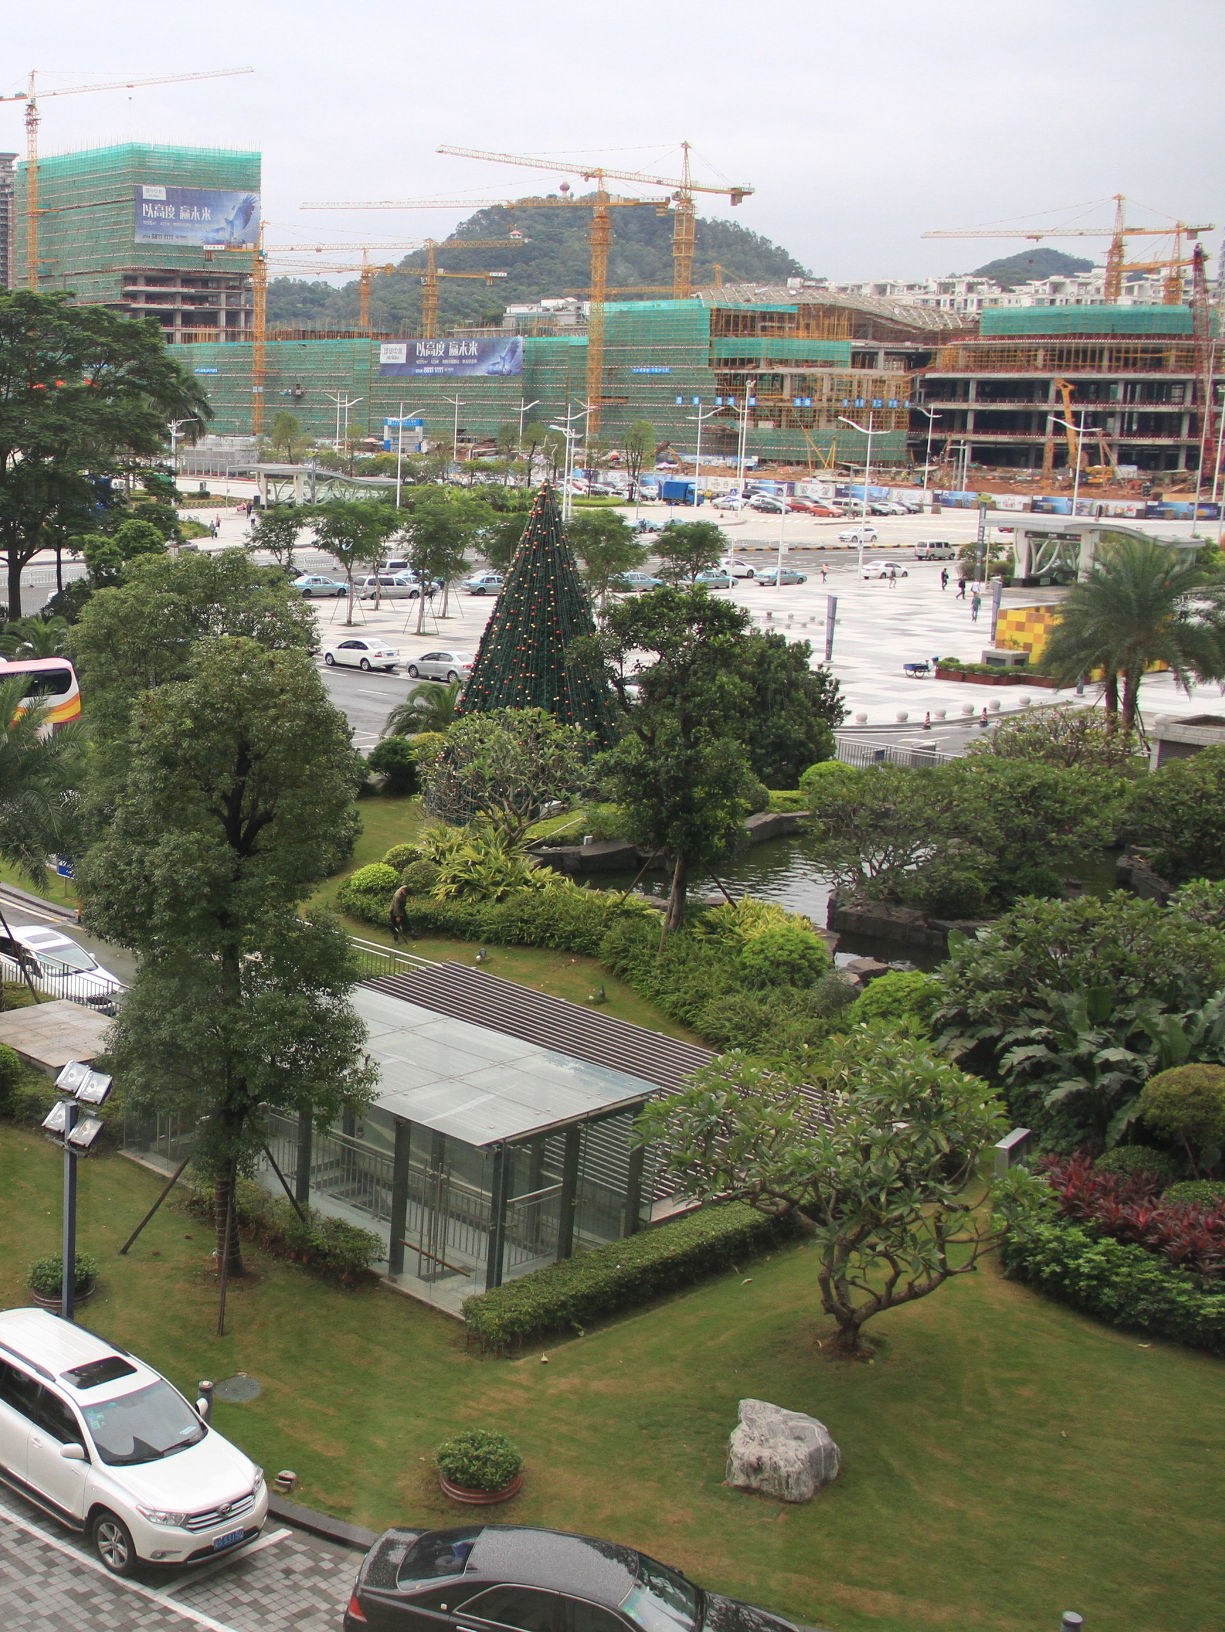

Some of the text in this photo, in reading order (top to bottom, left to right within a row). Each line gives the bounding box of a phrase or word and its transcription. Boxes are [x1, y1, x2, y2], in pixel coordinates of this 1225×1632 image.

[142, 203, 175, 220] 以高度
[416, 341, 445, 357] 以高度
